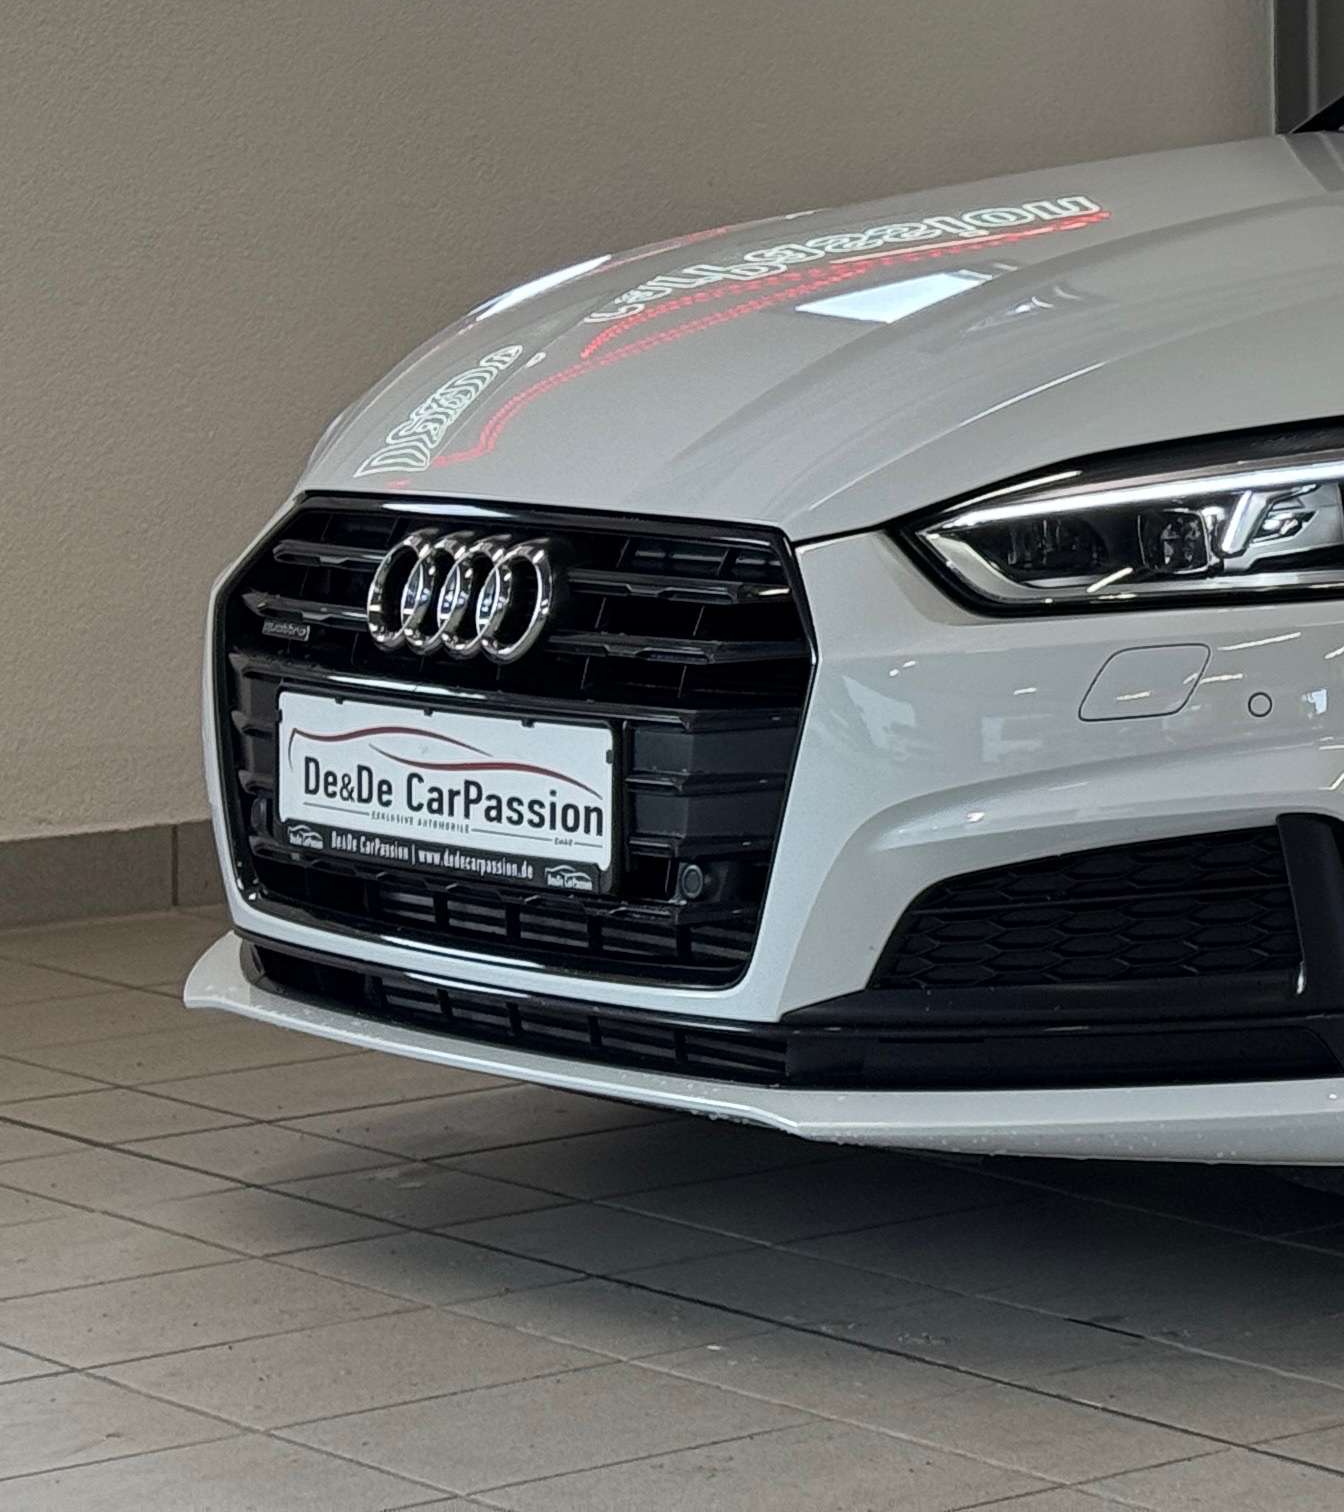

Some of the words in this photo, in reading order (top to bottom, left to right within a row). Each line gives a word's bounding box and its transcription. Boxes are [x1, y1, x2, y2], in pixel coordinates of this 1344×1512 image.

[303, 756, 393, 807] De&De
[405, 771, 605, 837] CarPassion
[331, 830, 358, 852] De&De
[360, 835, 409, 862] CarPassion
[418, 848, 534, 880] www.dedecarpassion.de
